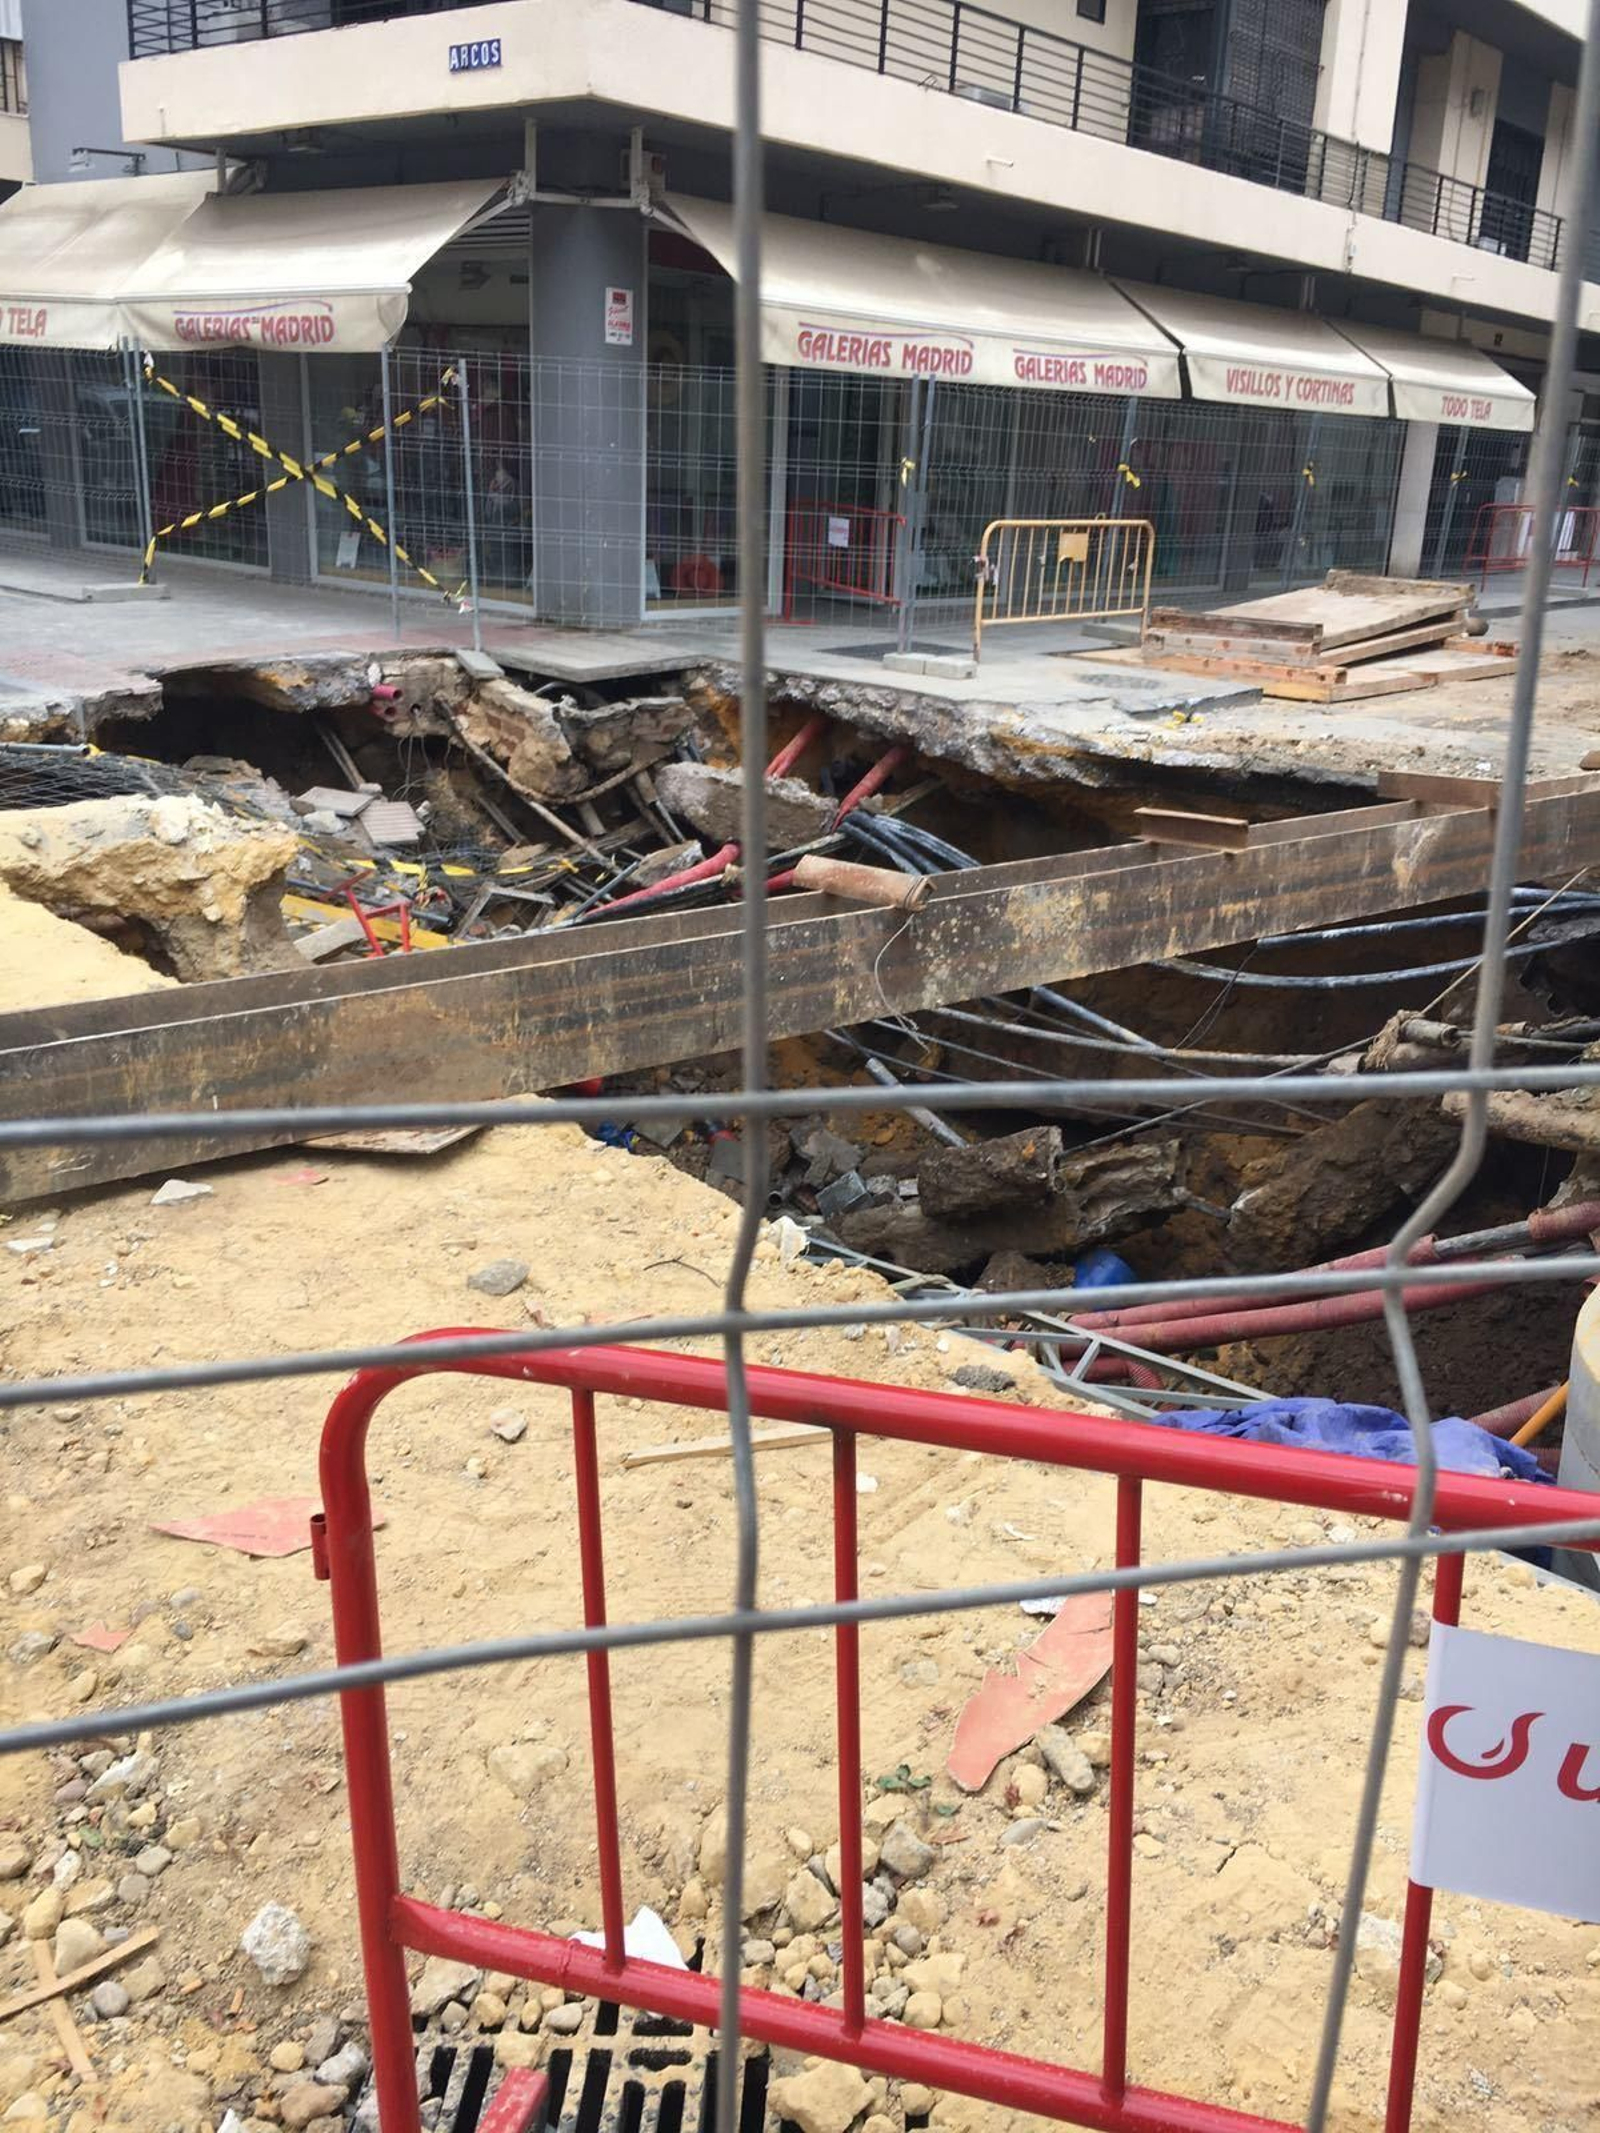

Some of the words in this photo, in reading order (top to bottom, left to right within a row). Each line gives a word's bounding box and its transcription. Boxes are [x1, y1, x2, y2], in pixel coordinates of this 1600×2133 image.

[450, 41, 500, 69] ARCOS
[8, 307, 47, 338] TELA
[174, 316, 252, 342] GALERIAS
[260, 315, 334, 345] MADRID
[797, 330, 892, 369] GALERIAS
[902, 342, 974, 376] MADRID
[1014, 355, 1087, 386] GALERIAS
[1093, 362, 1148, 391] MADRID
[1226, 368, 1281, 397] VISILLOS
[1286, 375, 1295, 401] Y
[1296, 378, 1356, 405] CORTINAS
[1441, 395, 1469, 418] TODO
[1470, 399, 1493, 421] TELA
